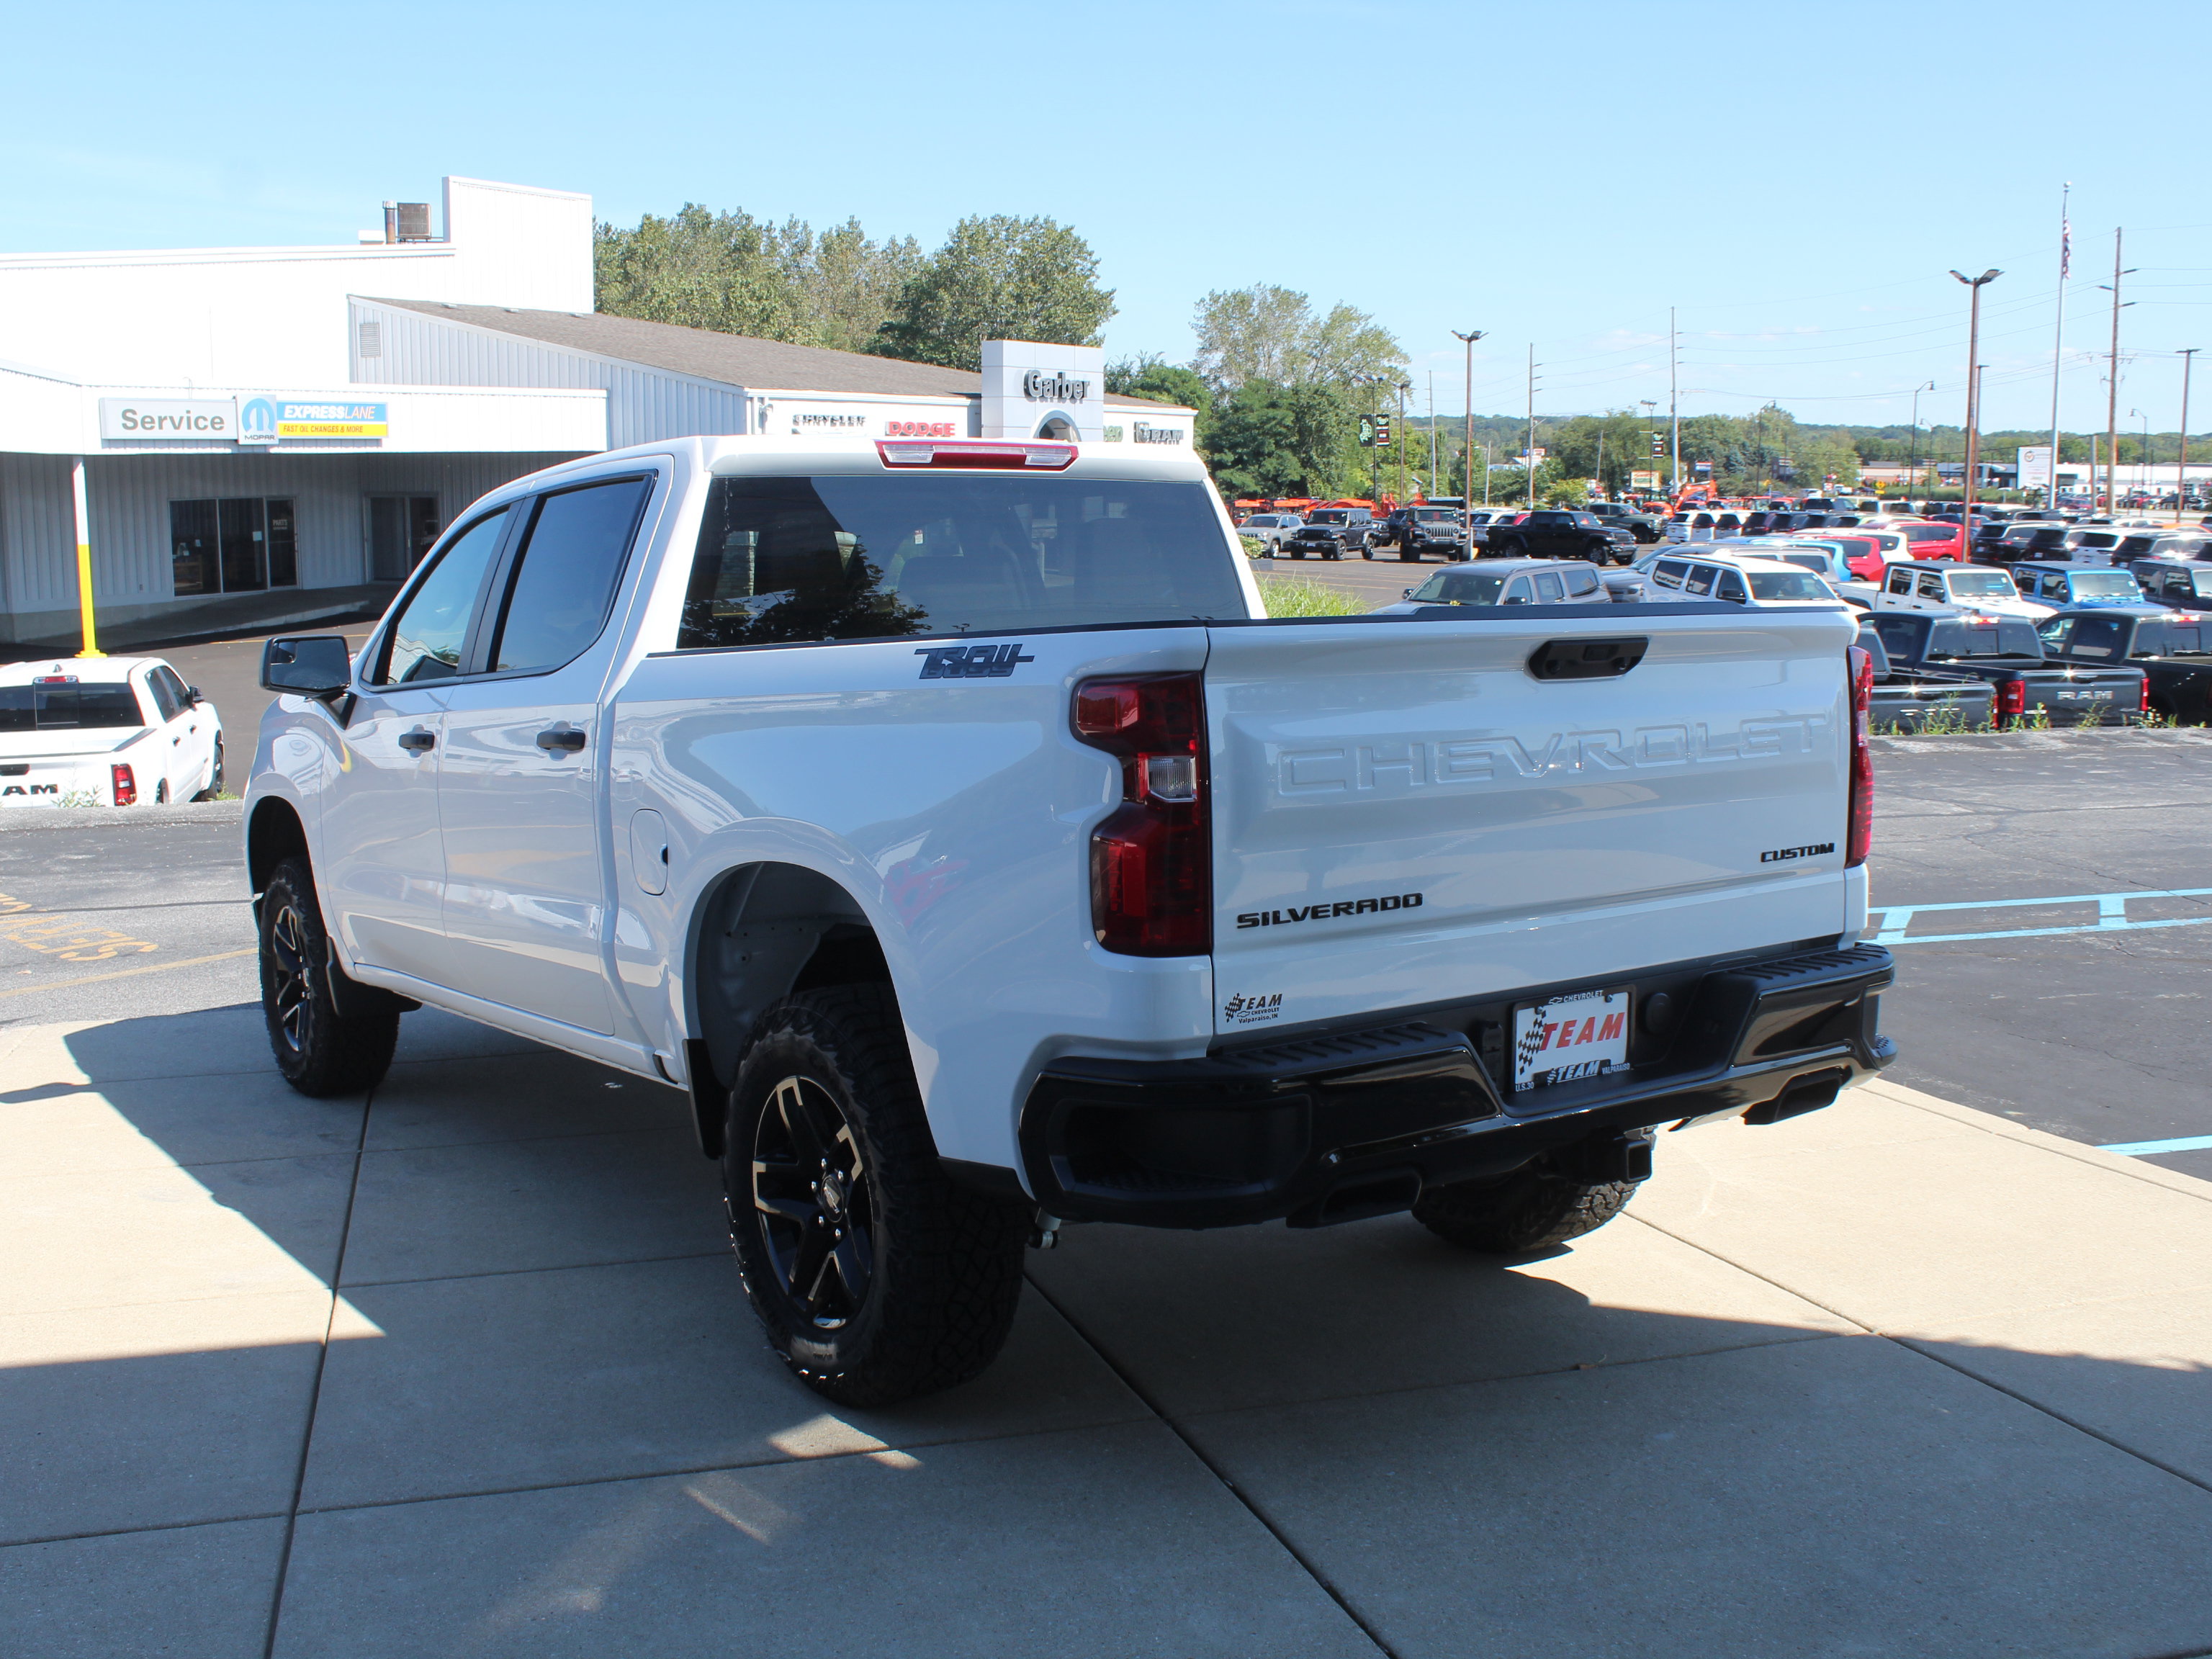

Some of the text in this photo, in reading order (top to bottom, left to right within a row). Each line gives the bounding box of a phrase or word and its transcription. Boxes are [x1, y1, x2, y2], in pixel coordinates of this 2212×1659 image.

[1024, 369, 1091, 400] Garber
[121, 409, 225, 431] Service
[284, 405, 377, 420] EXPRESSLANE
[283, 425, 298, 433] FAST
[300, 425, 309, 433] OIL
[310, 425, 339, 433] CHANGES
[792, 414, 866, 428] CHRYSLER
[885, 421, 956, 436] DODGE
[1103, 425, 1123, 443] eep
[1150, 429, 1184, 443] RAM
[914, 643, 1035, 667] TRAIL
[2056, 691, 2114, 701] RAM
[1276, 714, 1827, 796] CHEVROLET
[1, 783, 58, 796] AM
[1761, 842, 1835, 863] CUSTOM
[1236, 892, 1423, 929] SILVERADO
[1236, 994, 1282, 1011] TEAM
[1563, 989, 1604, 1003] CHEVROLET
[1251, 1007, 1280, 1015] CHEVROLET
[1238, 1015, 1272, 1024] Valparaiso,
[1539, 1012, 1625, 1051] TEAM
[1515, 1060, 1631, 1092] U.S.30 TEAM VALPARAISO
